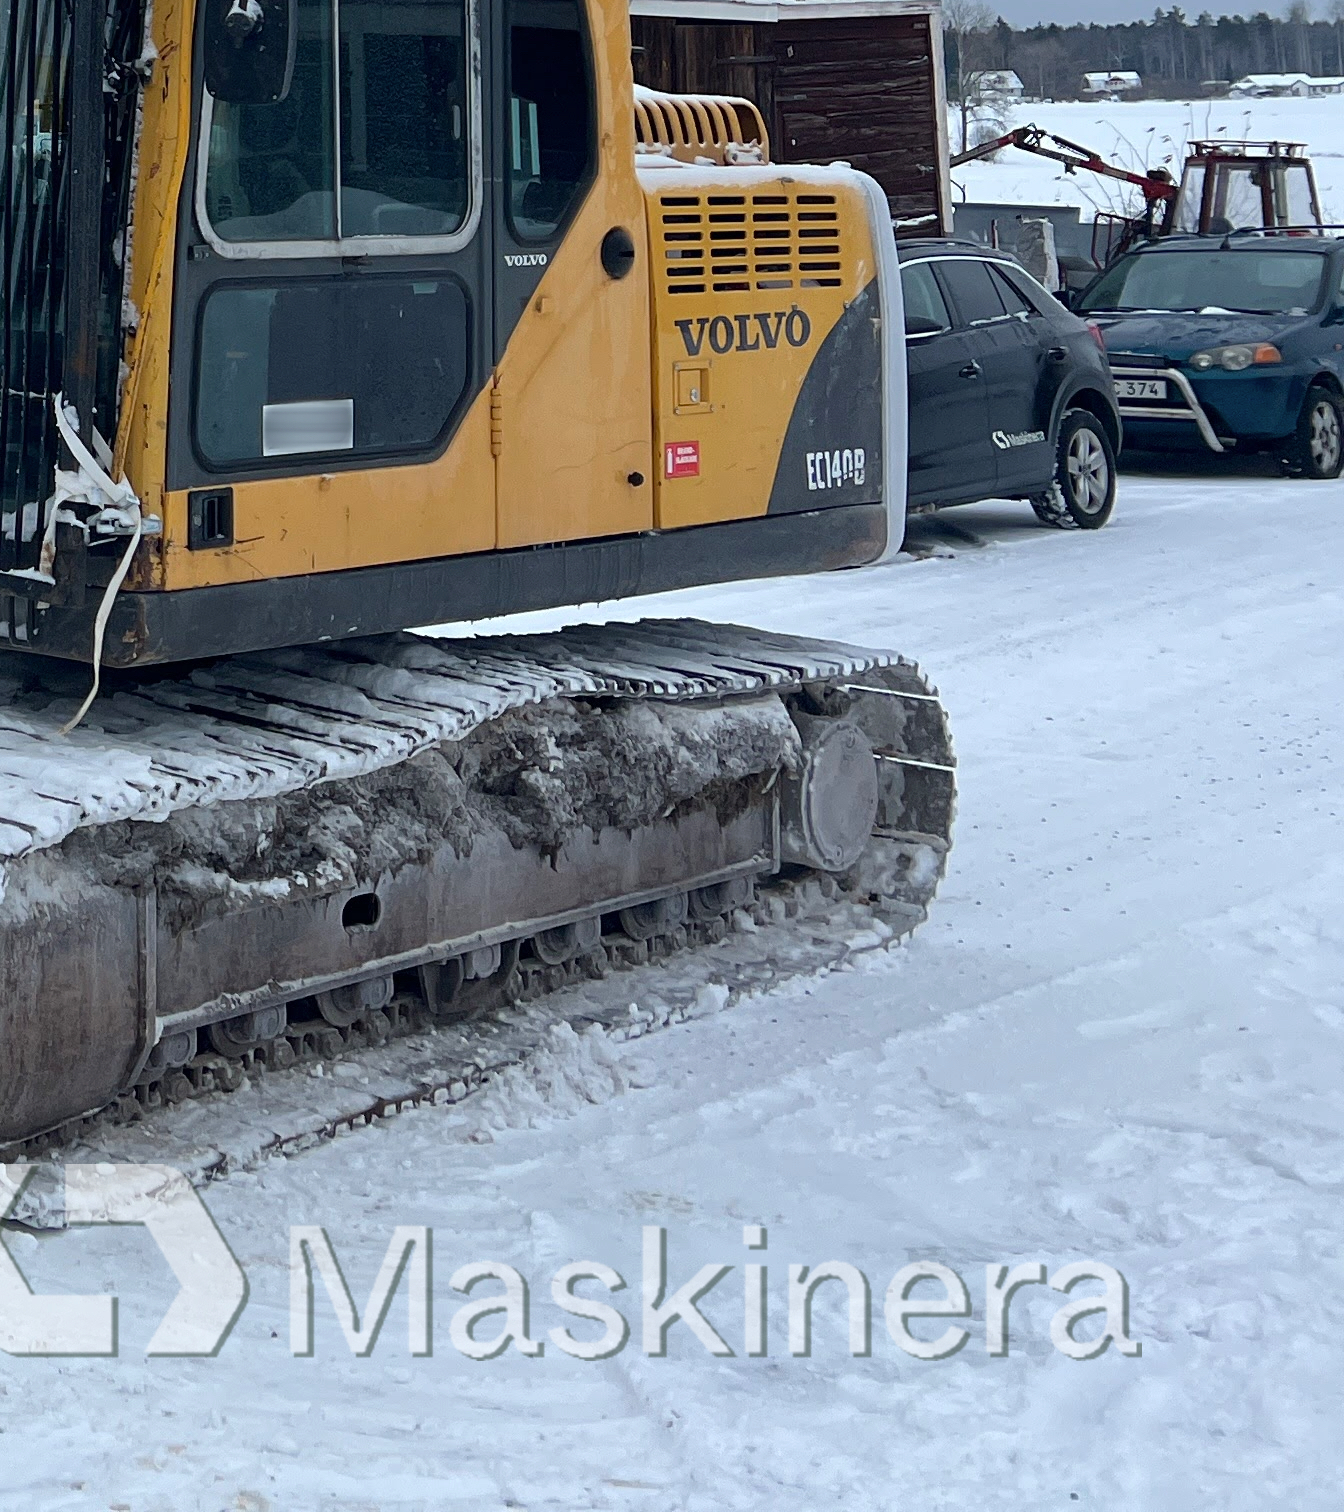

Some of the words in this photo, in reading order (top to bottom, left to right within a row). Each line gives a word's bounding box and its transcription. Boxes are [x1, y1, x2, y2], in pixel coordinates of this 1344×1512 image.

[504, 253, 548, 267] VOLVO
[674, 309, 811, 356] VOLVO
[1126, 382, 1158, 397] 374
